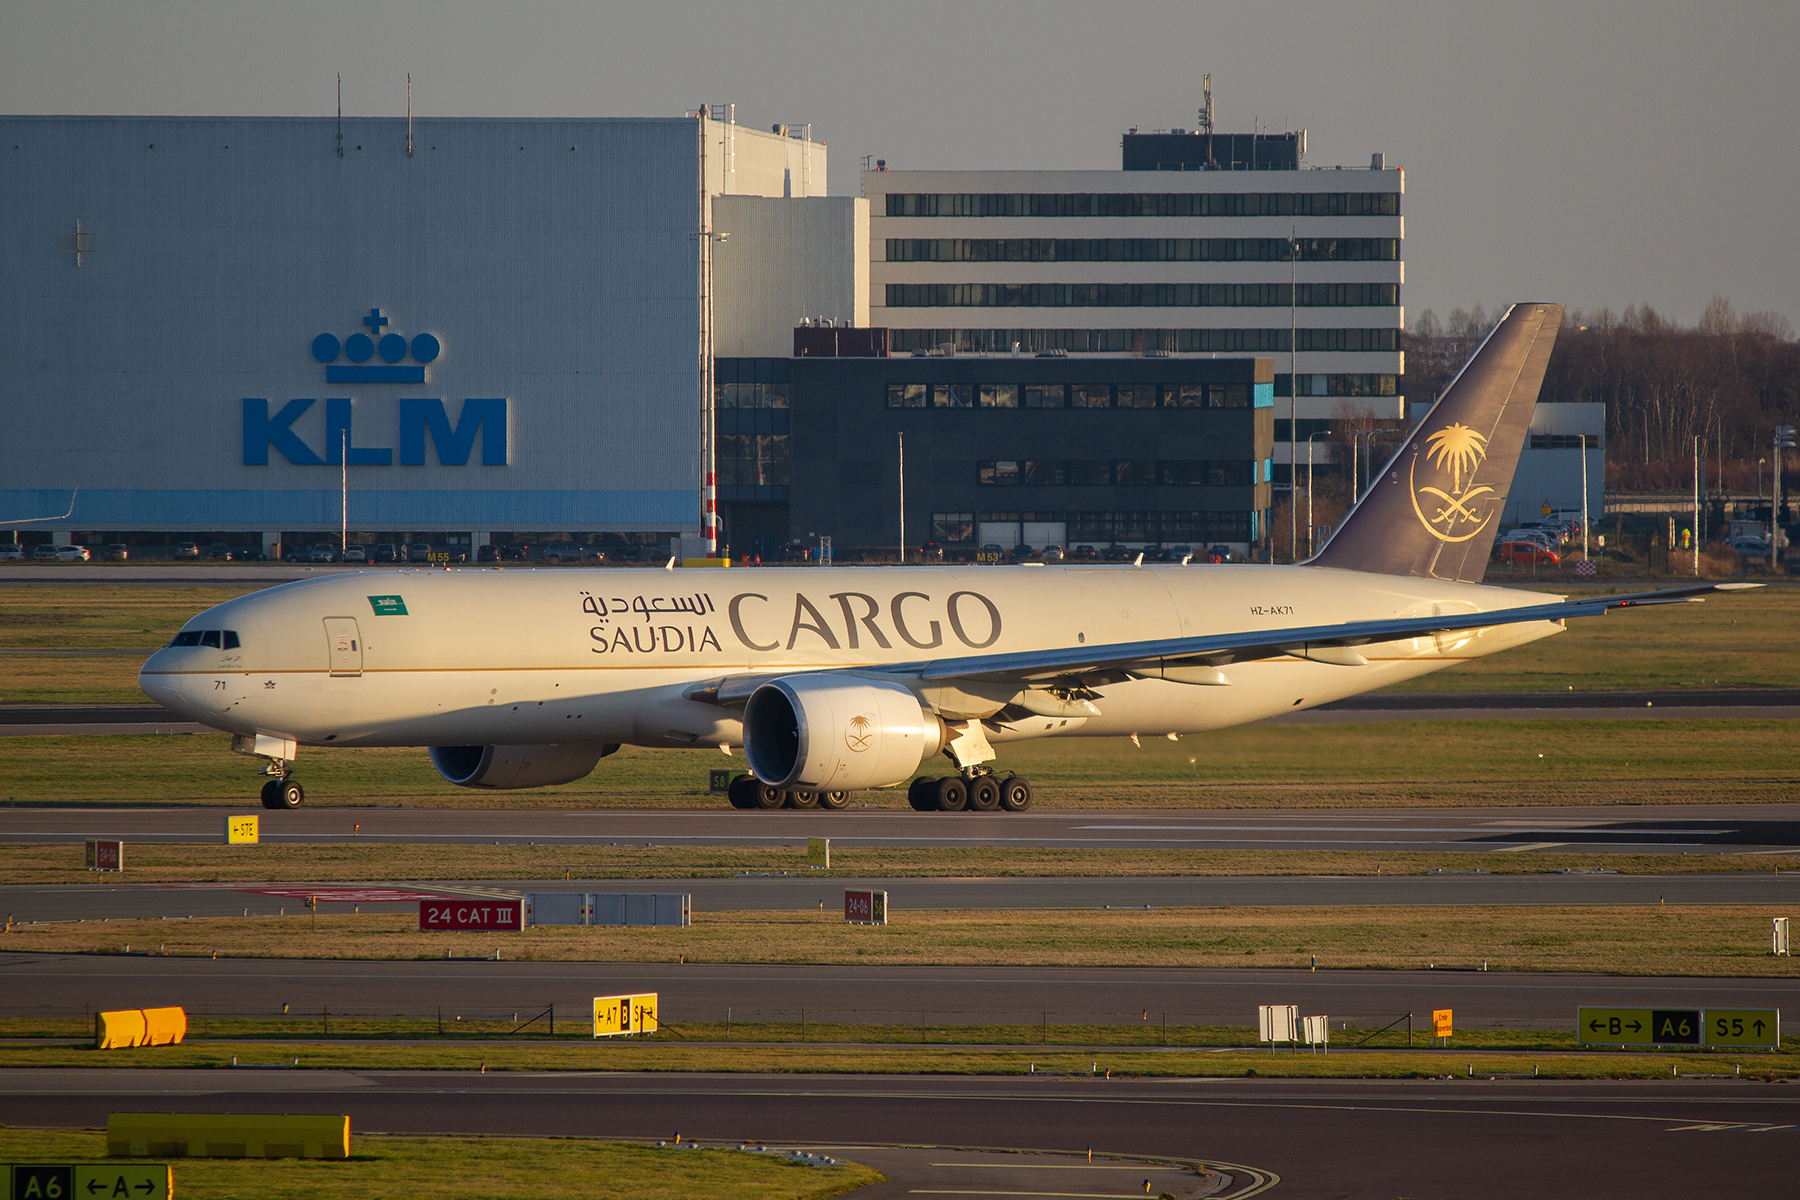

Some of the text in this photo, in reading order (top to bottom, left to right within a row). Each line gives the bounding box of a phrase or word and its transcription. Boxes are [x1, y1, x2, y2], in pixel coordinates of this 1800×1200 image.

[243, 398, 507, 465] KLM
[427, 552, 450, 561] M 55
[977, 552, 999, 561] M 53
[580, 591, 715, 623] السعودية
[1250, 606, 1294, 615] HZ-AK71
[728, 591, 1002, 651] CARGO
[590, 626, 722, 653] SAUDIA
[214, 681, 226, 690] 71
[714, 775, 725, 788] S8
[240, 823, 254, 836] S7E
[849, 898, 883, 915] 24-06 S6
[427, 908, 513, 924] 24 CAT III
[606, 1006, 617, 1025] A7
[622, 1005, 628, 1024] B
[1609, 1017, 1744, 1037] B A6 S5
[24, 1175, 130, 1199] A6 A
